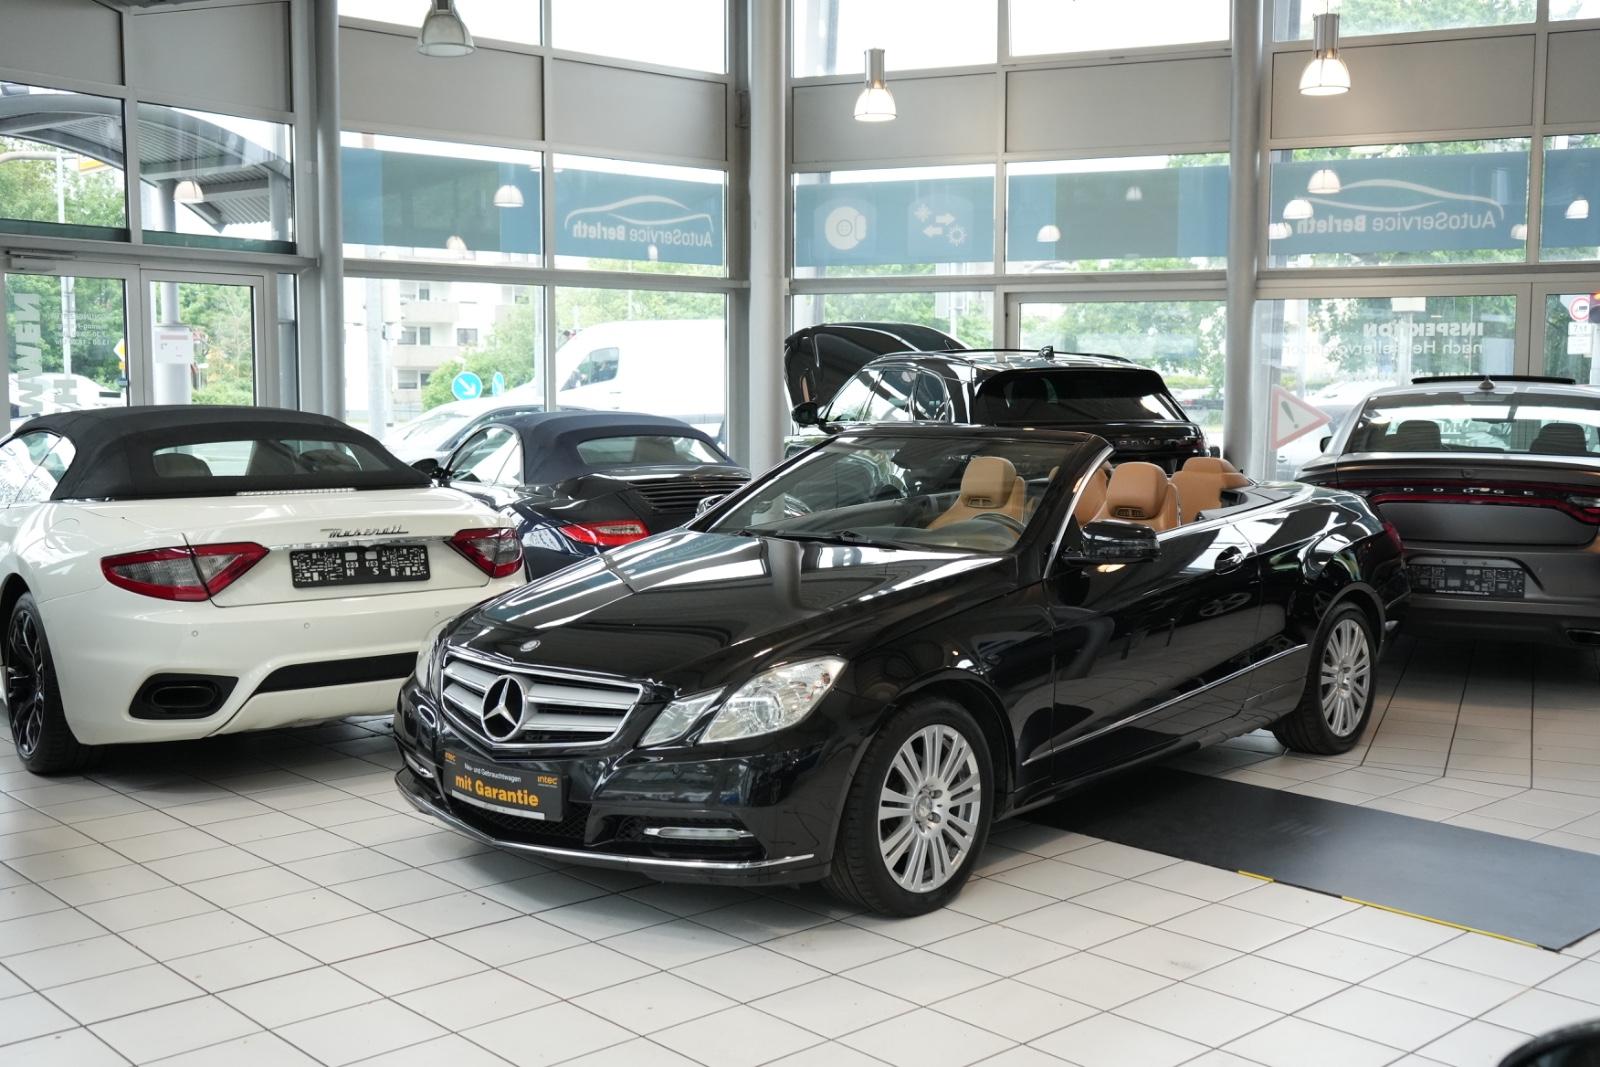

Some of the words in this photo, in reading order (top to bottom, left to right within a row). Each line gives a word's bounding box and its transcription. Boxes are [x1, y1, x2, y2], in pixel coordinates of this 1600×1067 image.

[1403, 486, 1535, 496] DODGE
[455, 775, 472, 792] mit
[475, 779, 539, 807] Garantie
